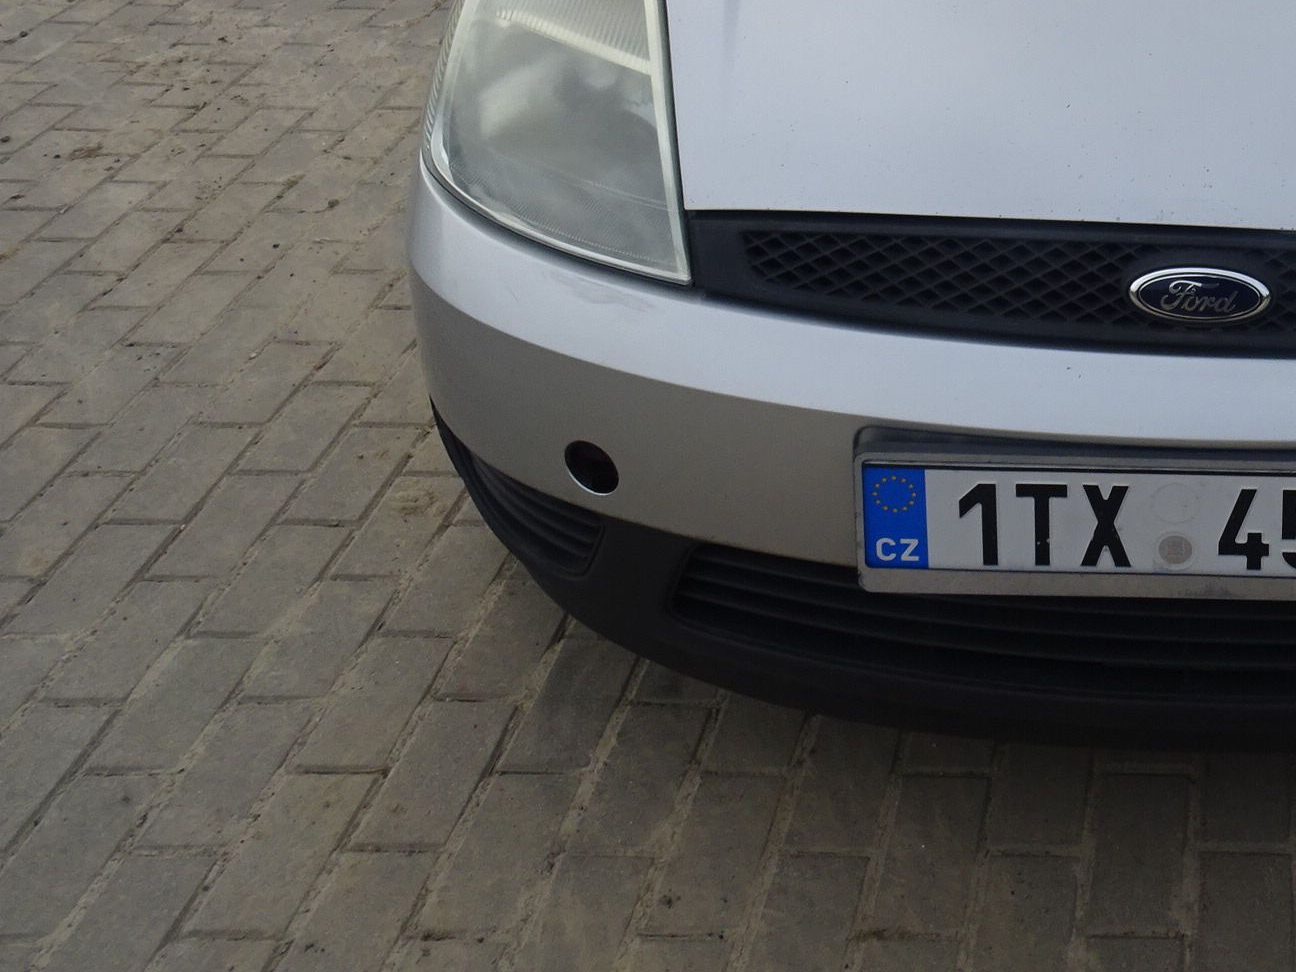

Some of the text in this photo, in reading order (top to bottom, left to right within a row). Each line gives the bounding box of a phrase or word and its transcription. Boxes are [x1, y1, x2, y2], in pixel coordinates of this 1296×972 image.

[1160, 280, 1239, 313] Ford
[958, 483, 1132, 567] 1TX
[875, 538, 920, 562] CZ
